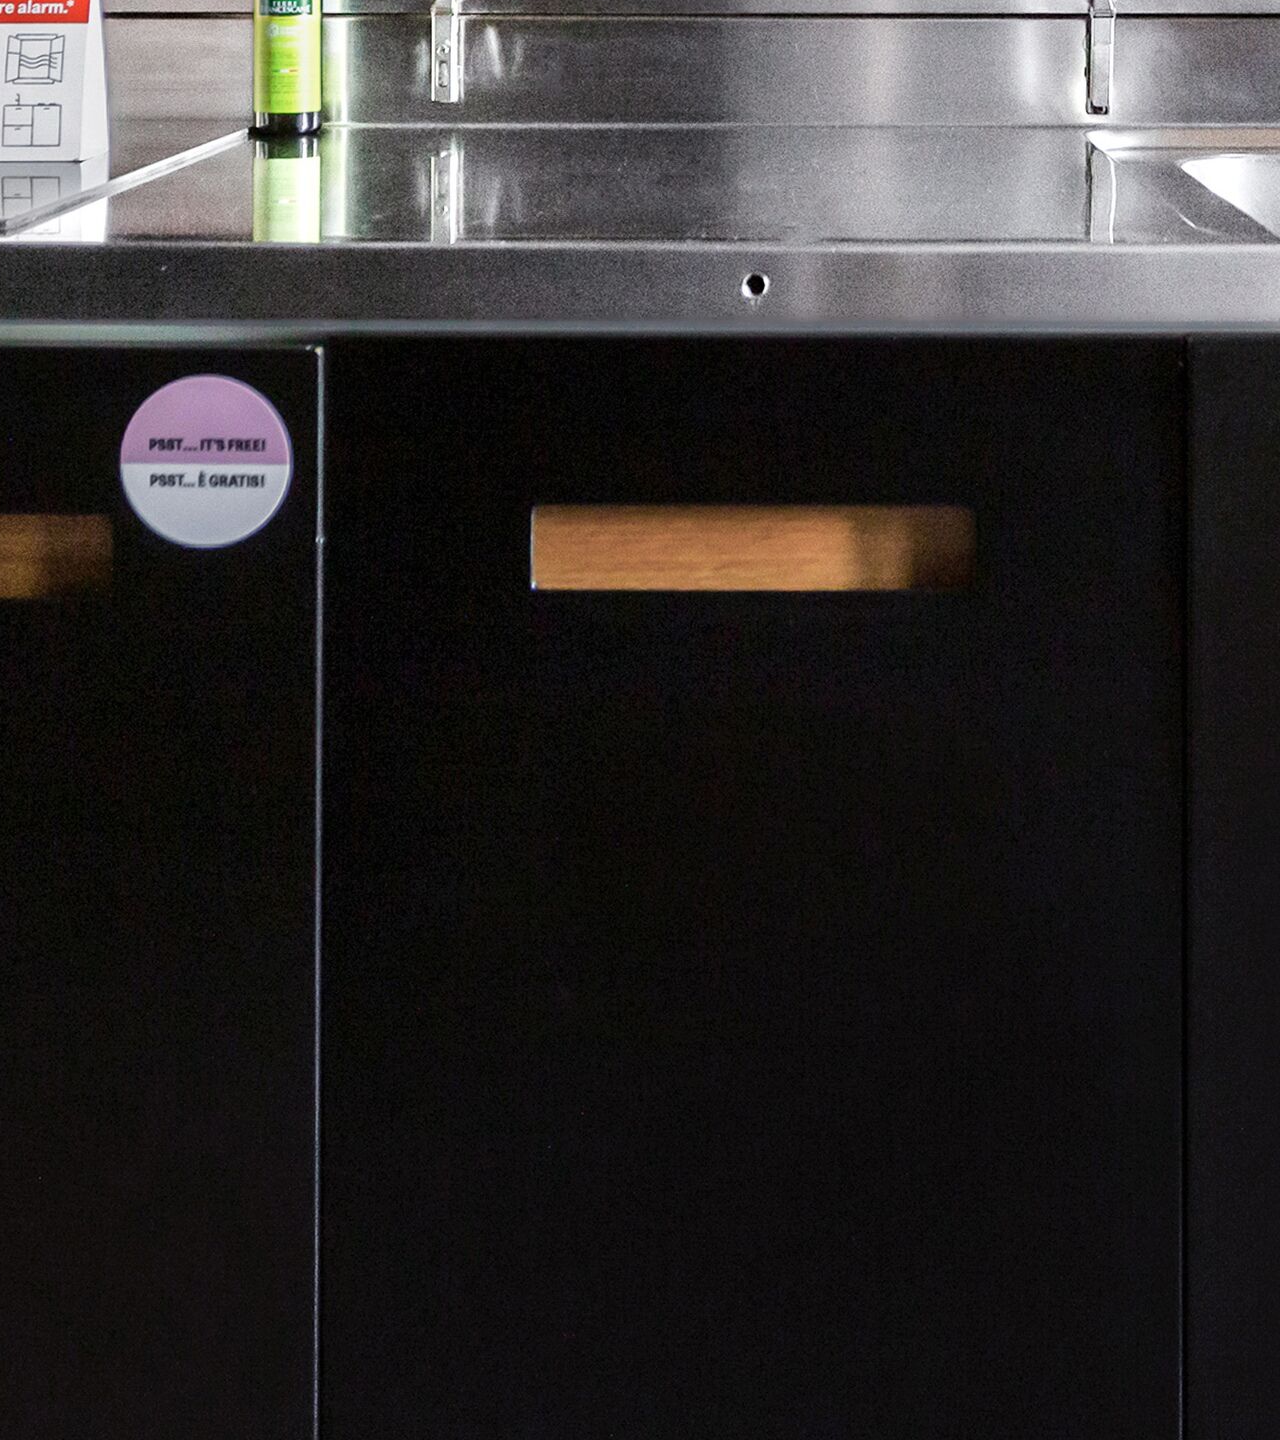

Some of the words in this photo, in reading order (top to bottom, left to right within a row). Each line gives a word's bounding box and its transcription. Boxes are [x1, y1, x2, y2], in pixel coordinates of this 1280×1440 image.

[200, 438, 225, 452] IT'S
[227, 438, 266, 452] FREE!
[197, 470, 207, 488] È
[208, 474, 266, 488] GRATIS!
